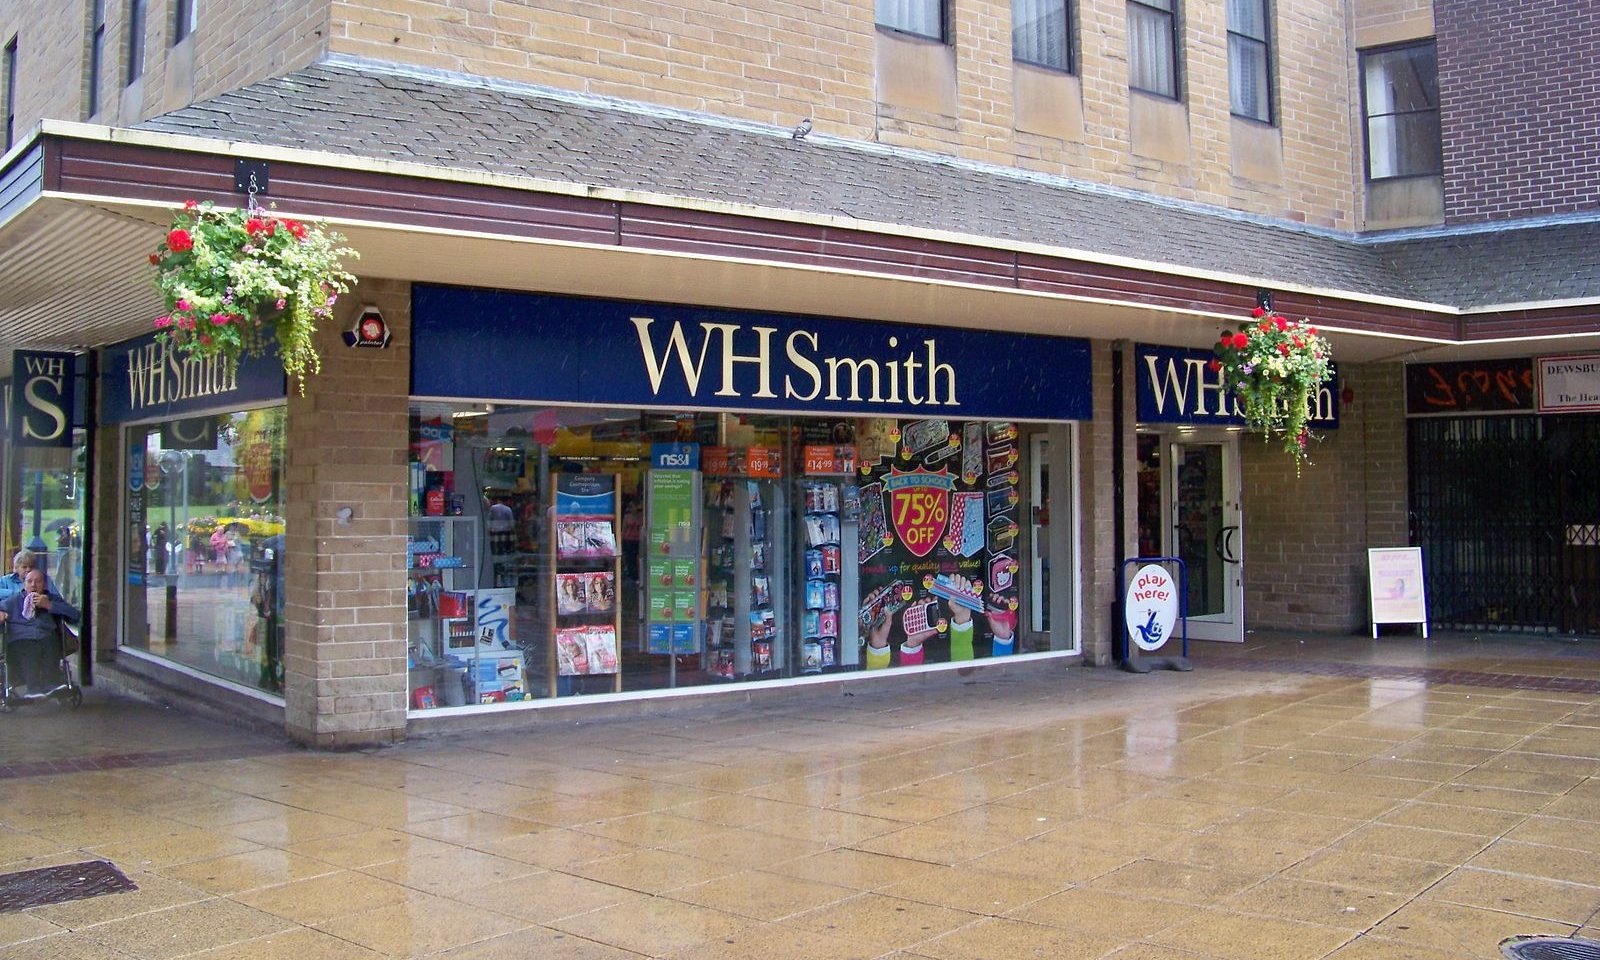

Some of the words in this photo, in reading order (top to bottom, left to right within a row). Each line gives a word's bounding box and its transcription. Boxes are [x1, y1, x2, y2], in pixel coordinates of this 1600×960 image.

[24, 356, 65, 376] WH
[629, 316, 960, 406] WHSmith
[1549, 364, 1600, 375] DEWSBU
[1144, 355, 1336, 421] WHith
[1558, 394, 1577, 403] The
[22, 376, 66, 440] S
[896, 493, 945, 525] 75%
[906, 527, 935, 544] OFF
[900, 561, 910, 575] for
[912, 559, 939, 574] quality
[960, 559, 980, 569] value!
[1138, 574, 1167, 589] play
[1135, 589, 1169, 602] here!
